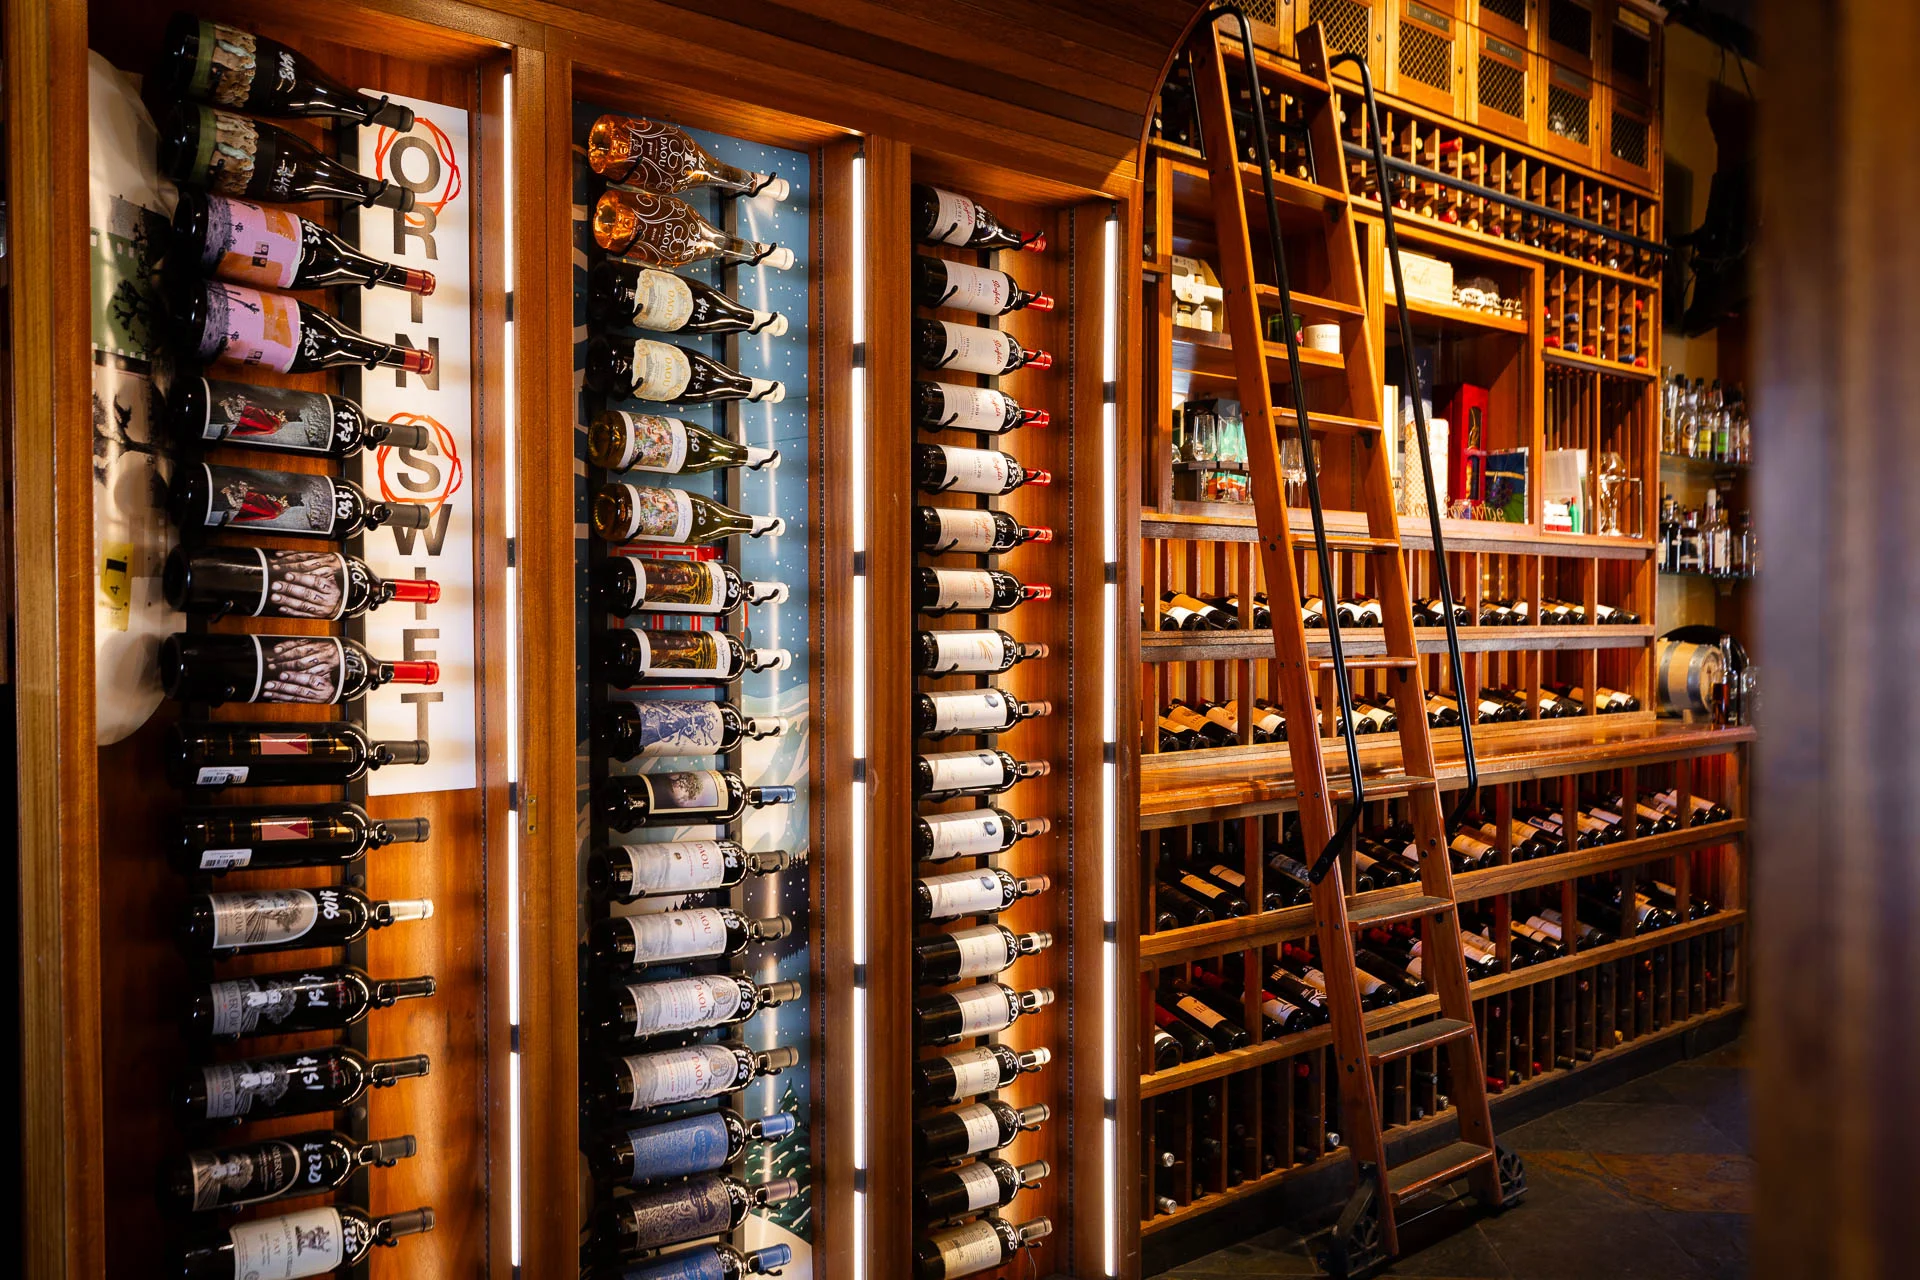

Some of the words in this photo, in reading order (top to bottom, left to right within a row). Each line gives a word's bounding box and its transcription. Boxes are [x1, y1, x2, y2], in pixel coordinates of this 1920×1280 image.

[658, 137, 668, 167] DAOU
[659, 222, 673, 253] DAOU
[663, 290, 675, 320] DAOU
[662, 357, 673, 387] DAOU
[695, 843, 710, 870] DAOU
[695, 911, 712, 936] DAOU
[694, 984, 707, 1014] DAOU
[691, 1056, 704, 1087] DAOU
